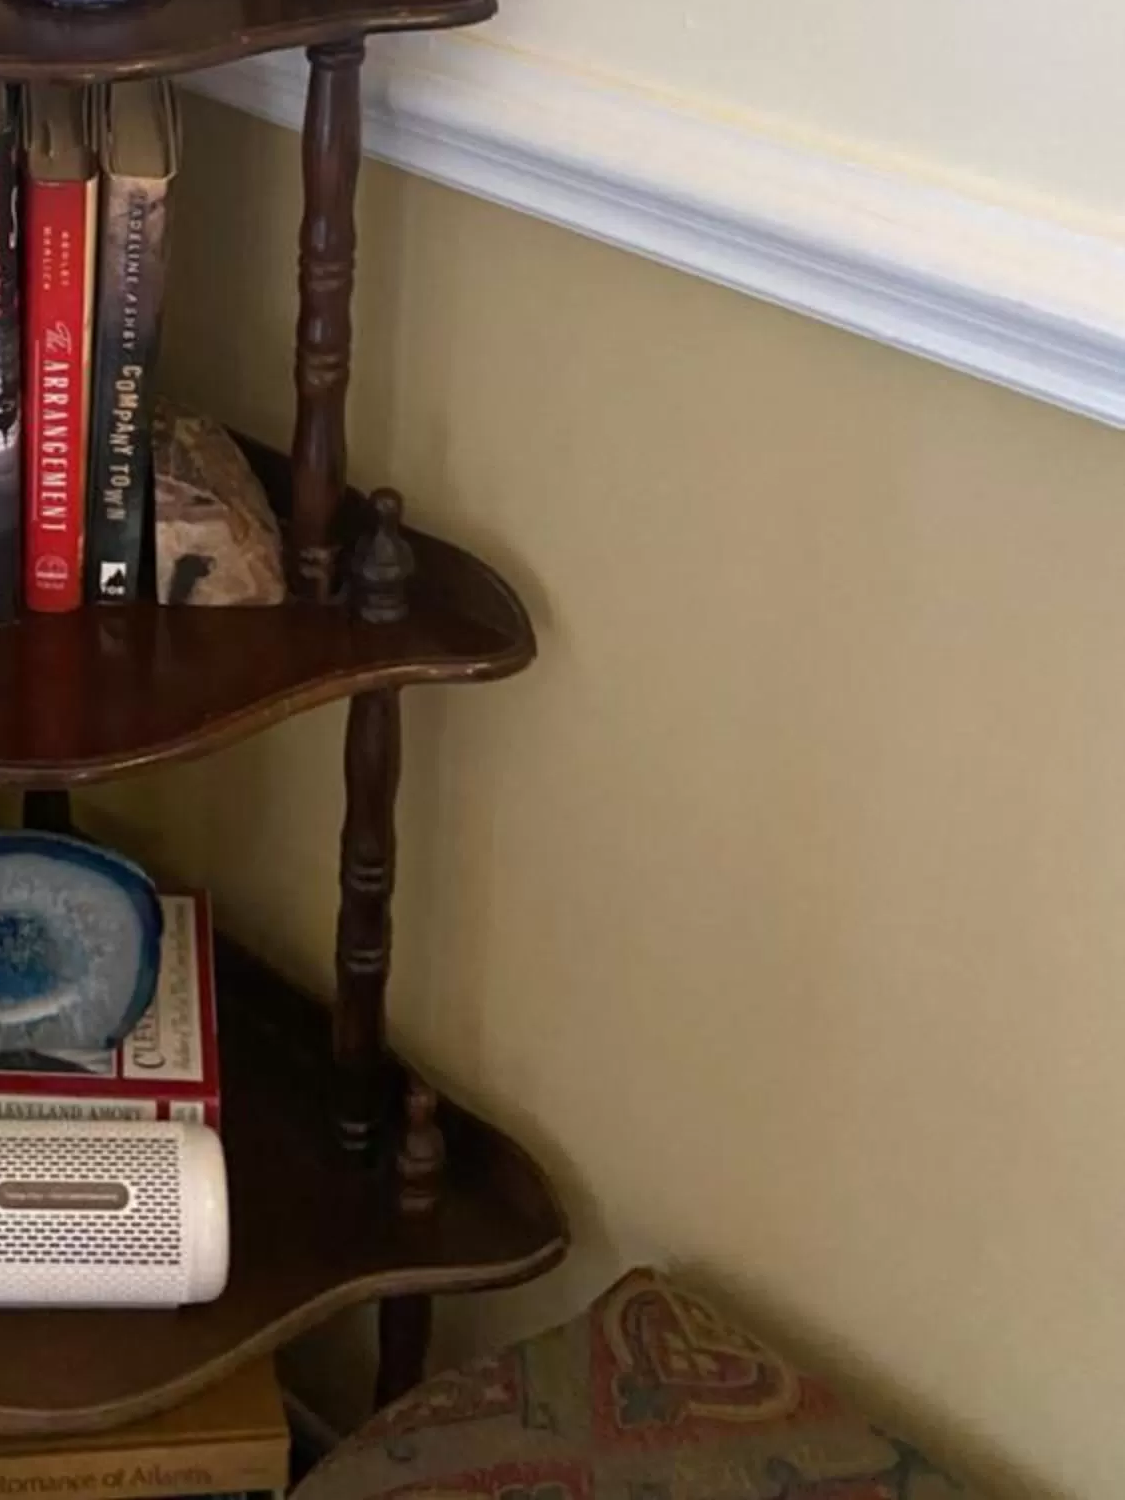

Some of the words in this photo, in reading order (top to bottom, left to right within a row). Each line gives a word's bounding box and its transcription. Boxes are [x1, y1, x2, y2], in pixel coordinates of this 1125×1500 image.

[44, 321, 72, 356] The
[122, 292, 138, 350] ASHBY
[108, 364, 143, 457] COMPANY
[40, 359, 70, 532] ARRANGEMENT
[102, 464, 132, 521] TOWN
[102, 1466, 130, 1487] of
